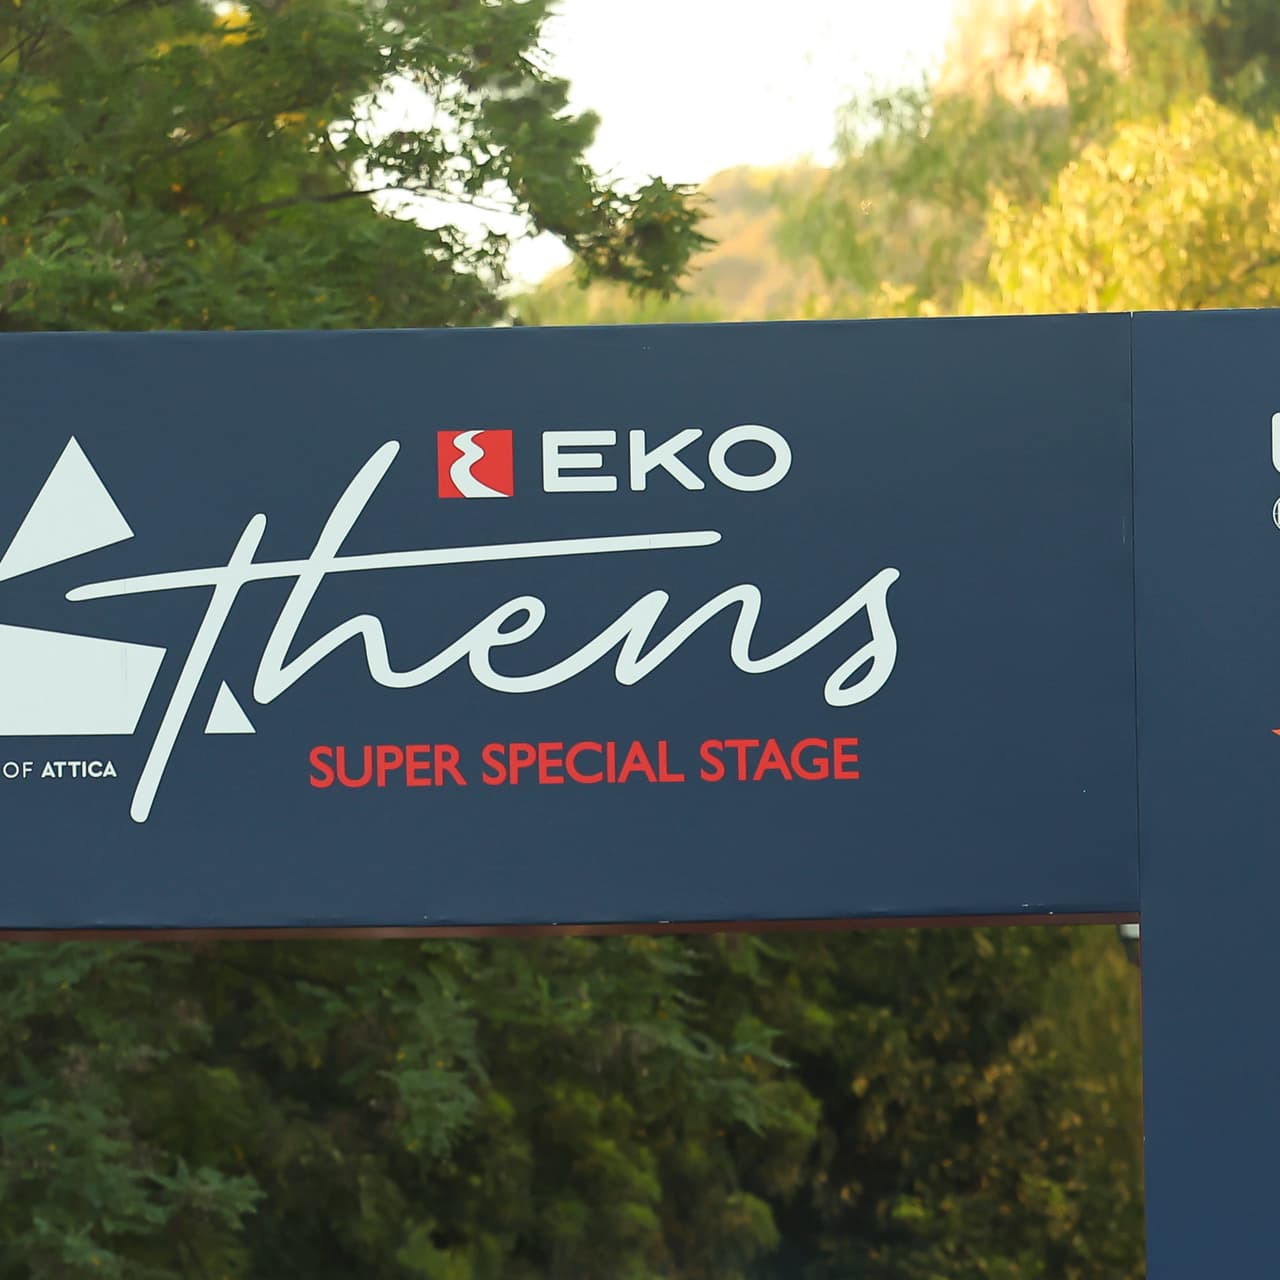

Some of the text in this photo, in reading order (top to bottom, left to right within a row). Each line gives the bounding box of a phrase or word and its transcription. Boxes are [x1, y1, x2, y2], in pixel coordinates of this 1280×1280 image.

[542, 424, 792, 493] EKO
[2, 761, 34, 779] OF
[41, 760, 118, 779] ATTICA
[309, 737, 861, 789] SUPER SPECIAL STAGE
